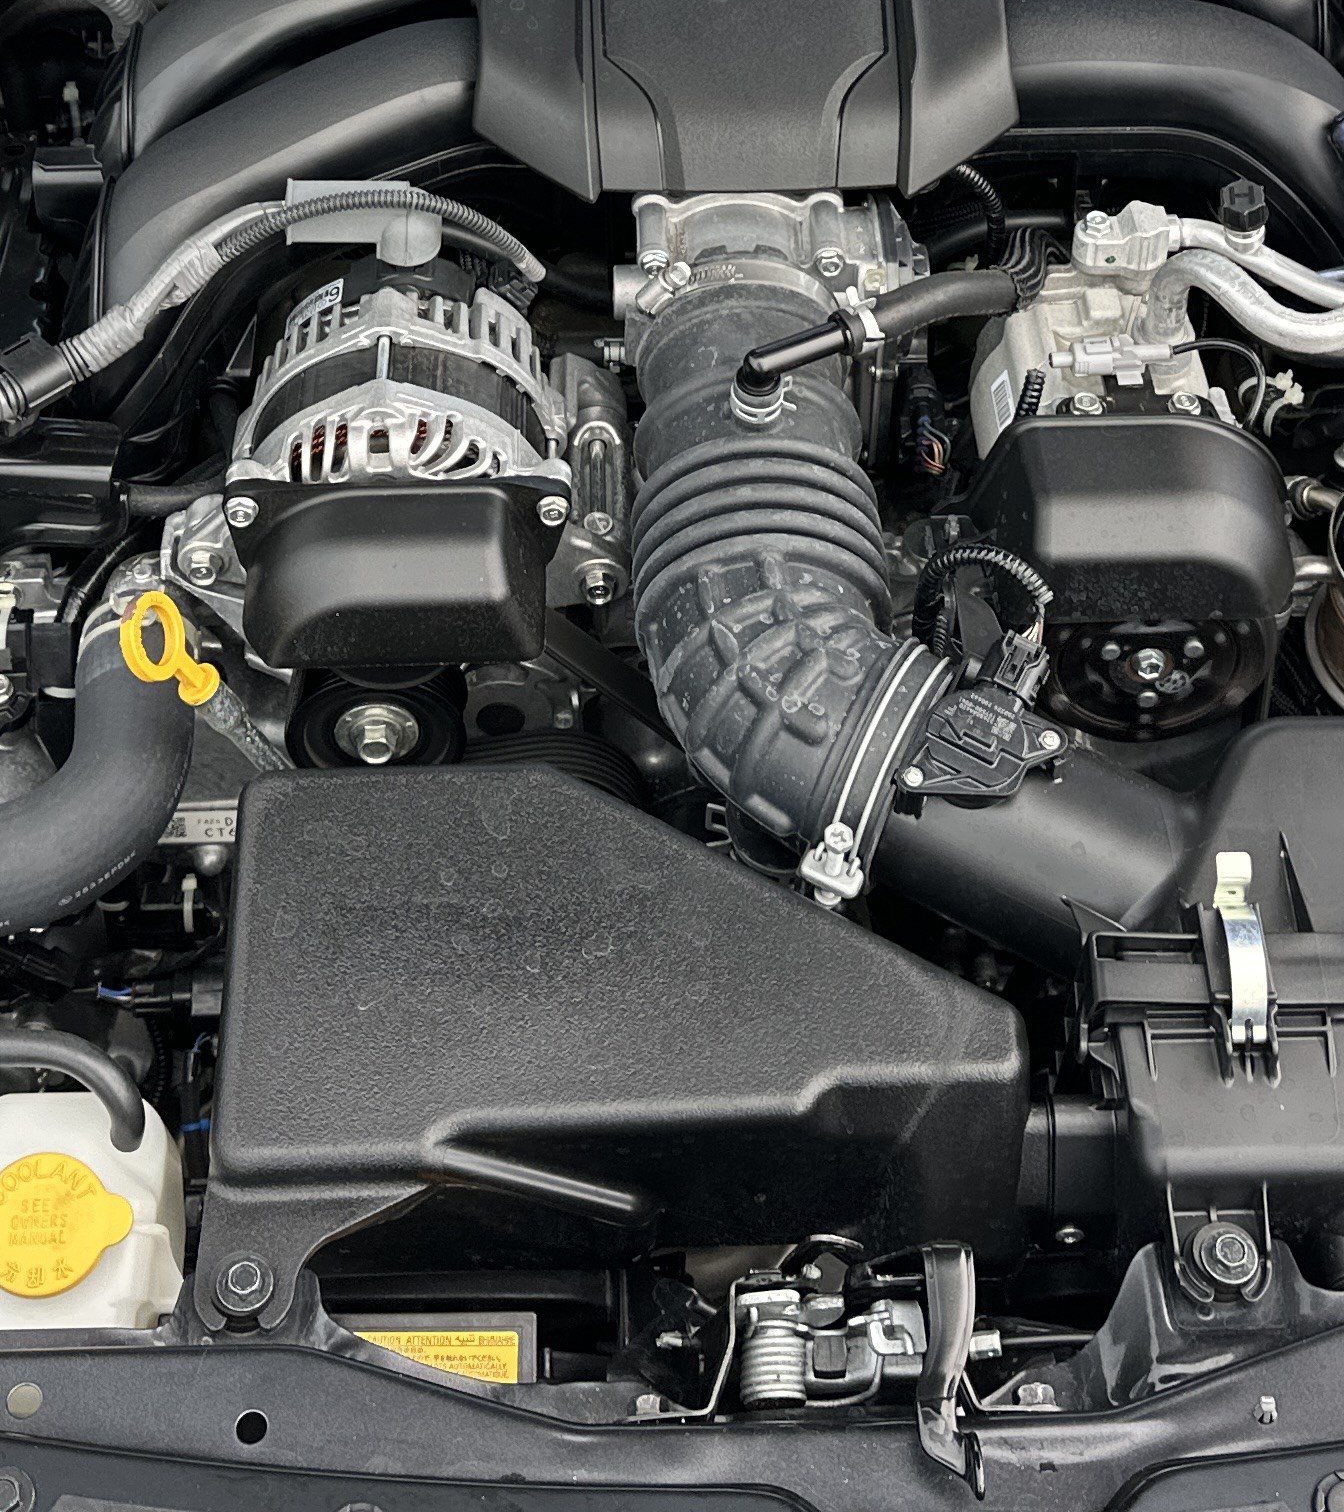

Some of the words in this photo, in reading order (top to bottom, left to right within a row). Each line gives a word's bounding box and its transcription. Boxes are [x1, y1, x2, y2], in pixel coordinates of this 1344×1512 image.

[20, 1198, 51, 1214] SEE
[7, 1229, 67, 1247] MANUAL
[406, 1335, 452, 1346] ATTENTION
